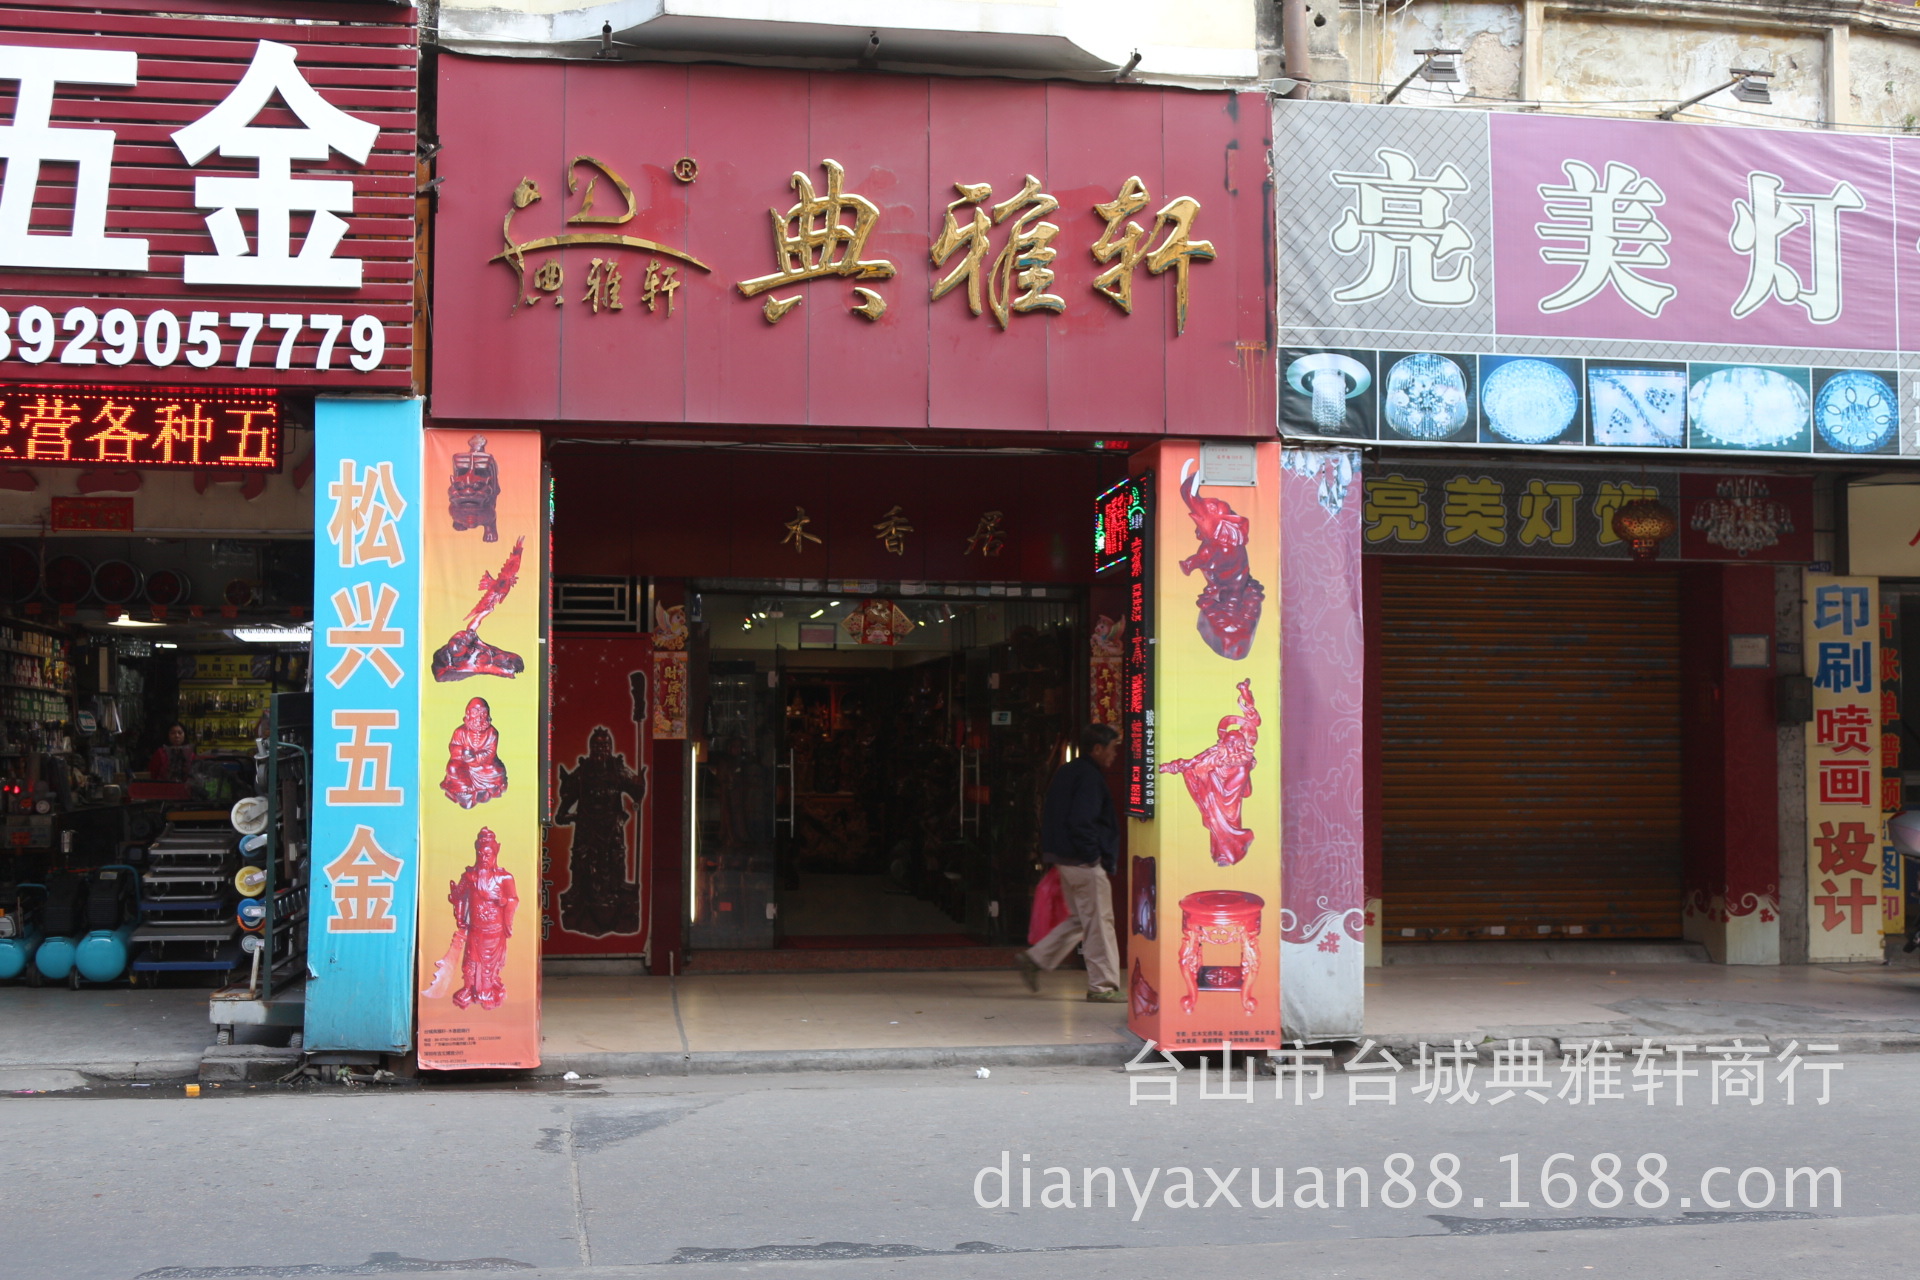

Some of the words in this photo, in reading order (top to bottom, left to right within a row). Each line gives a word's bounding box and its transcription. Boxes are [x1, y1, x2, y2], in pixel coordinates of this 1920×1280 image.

[0, 39, 381, 289] 五金
[736, 158, 1217, 336] 典雅轩
[1328, 146, 1920, 325] 亮美灯
[325, 460, 406, 934] 松兴五金
[1813, 584, 1877, 935] 印刷喷画设计
